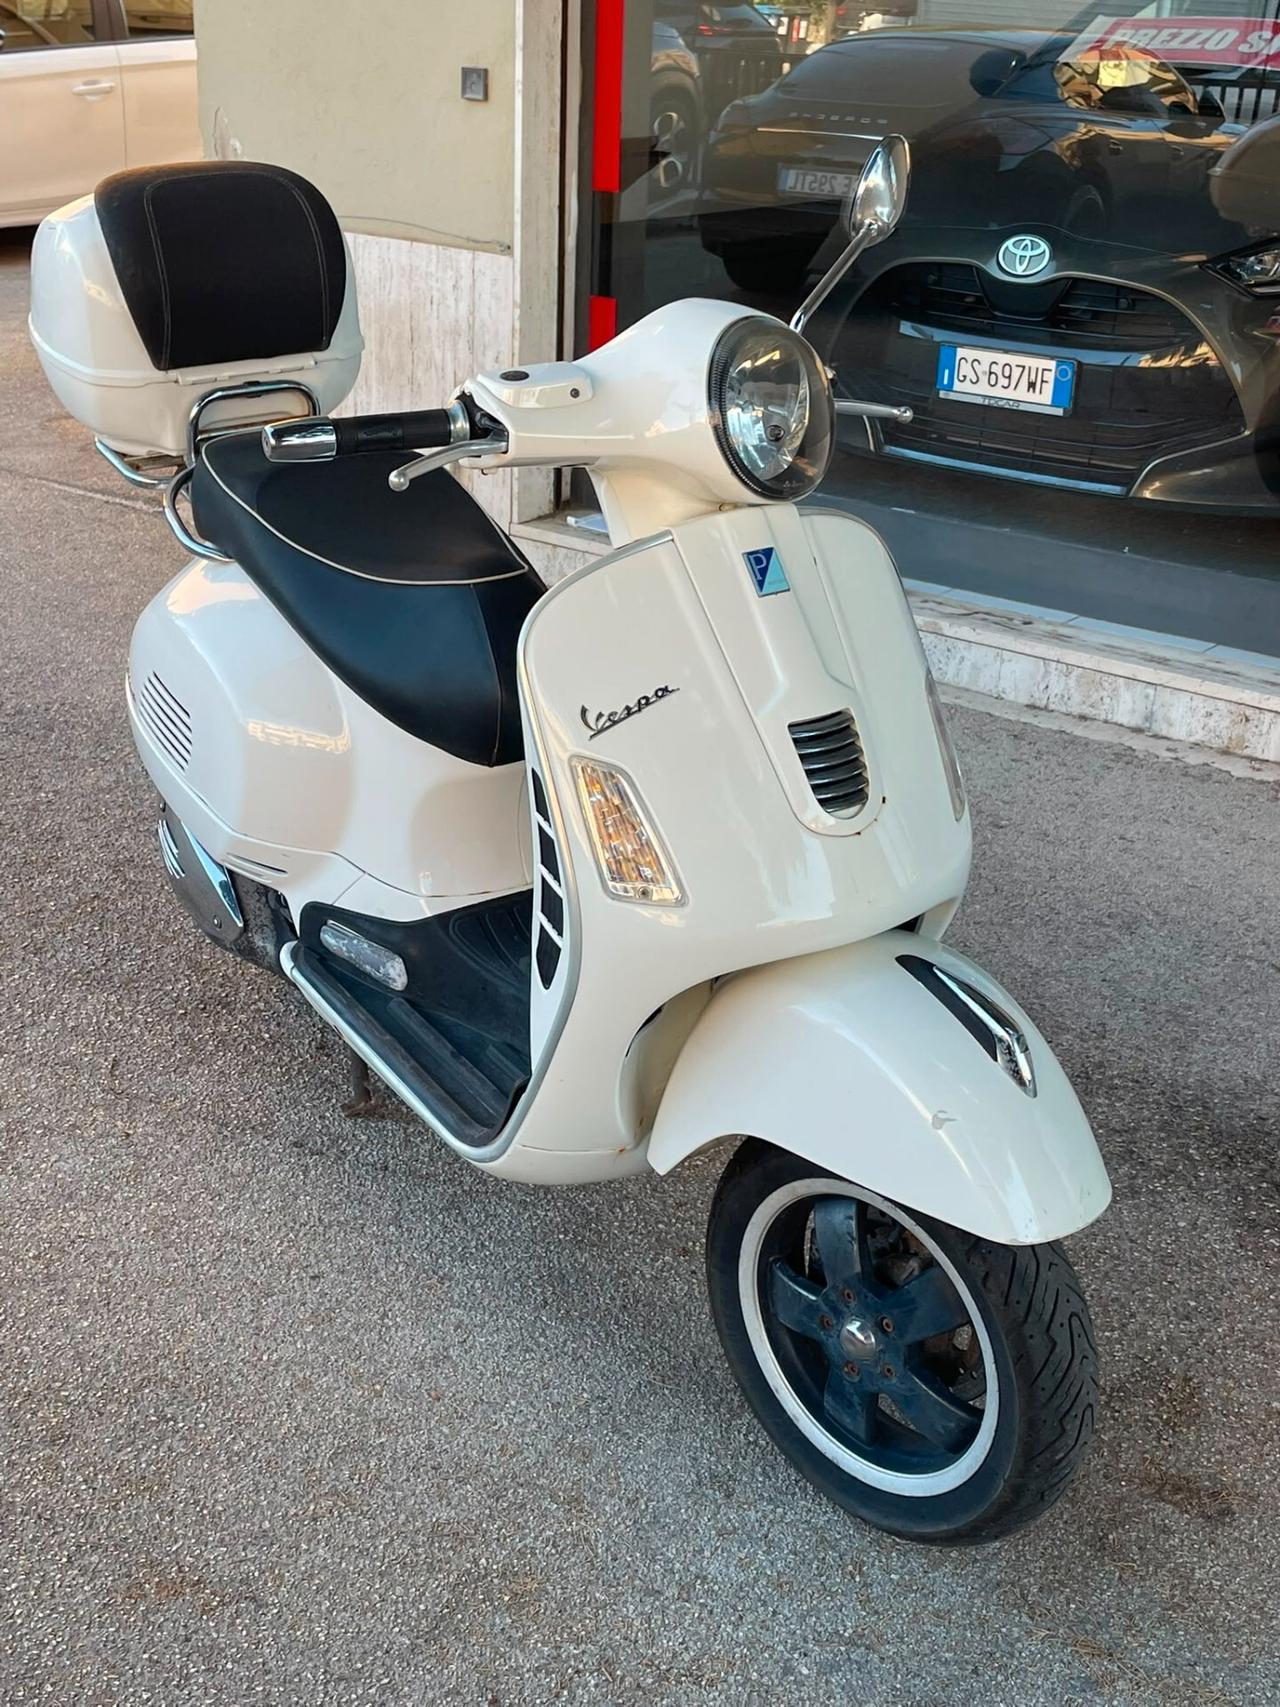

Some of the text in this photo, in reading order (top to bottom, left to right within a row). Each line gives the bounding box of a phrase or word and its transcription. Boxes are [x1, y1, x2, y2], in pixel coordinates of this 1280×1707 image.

[1101, 27, 1239, 51] PREZZO
[748, 554, 768, 580] P
[580, 684, 681, 741] Vespa
